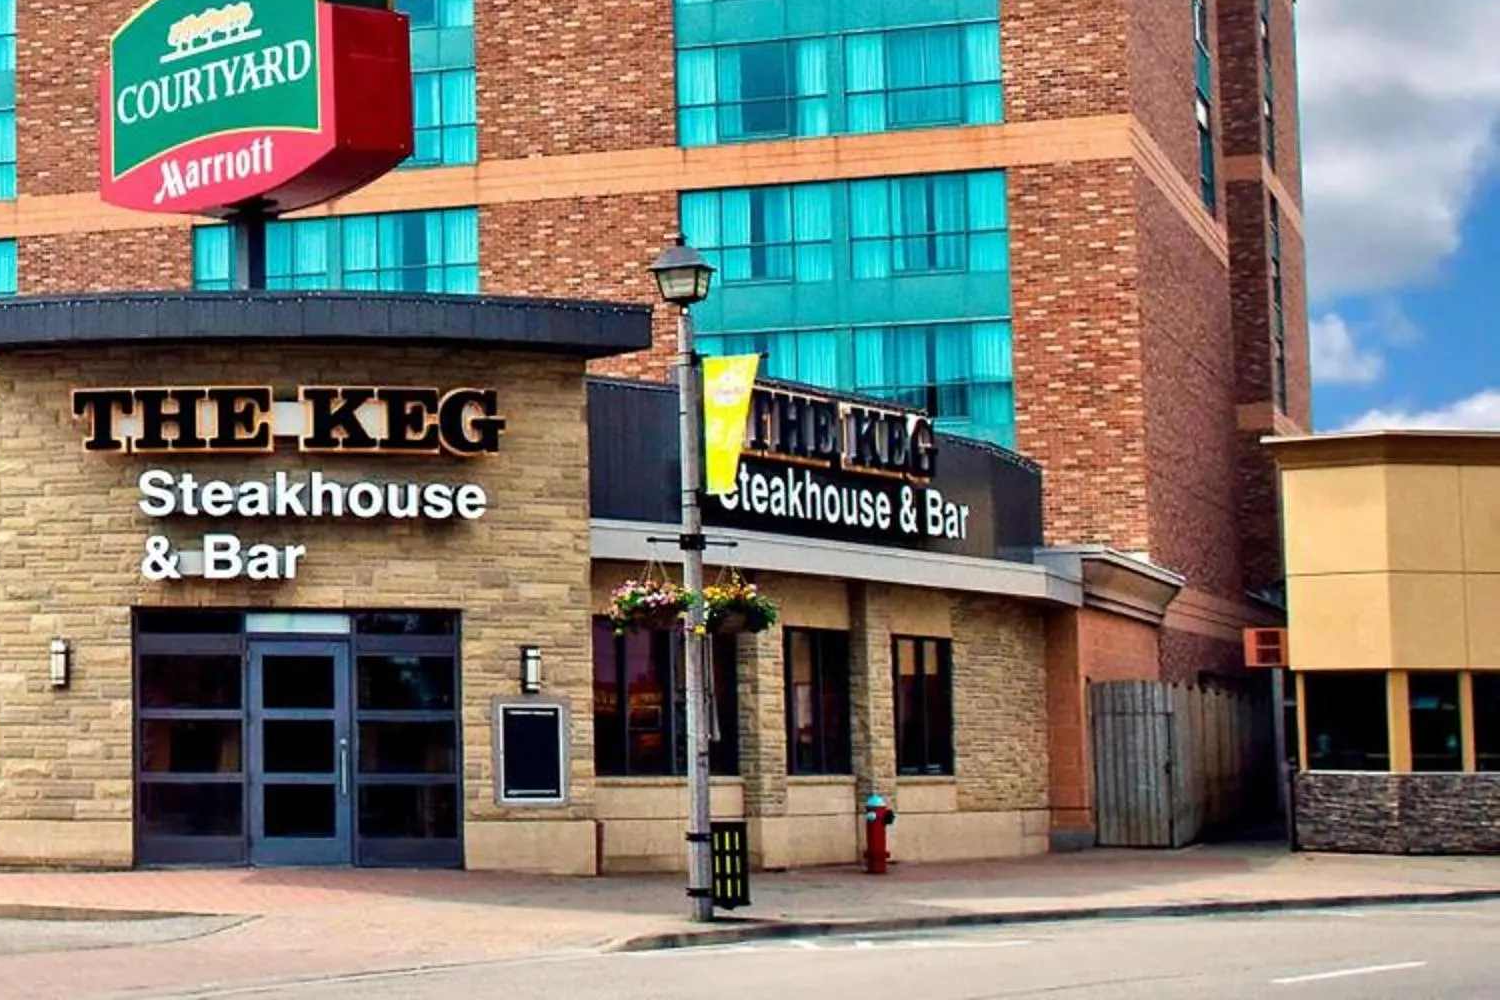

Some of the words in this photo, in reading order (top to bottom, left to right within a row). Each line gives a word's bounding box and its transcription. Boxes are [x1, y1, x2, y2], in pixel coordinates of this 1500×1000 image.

[117, 39, 311, 124] COURTYARD
[153, 136, 274, 204] Marriott
[72, 386, 274, 453] THE
[298, 386, 506, 456] KEG
[838, 400, 938, 484] KEG
[138, 470, 487, 518] Steakhouse
[900, 484, 918, 534] &
[926, 488, 969, 540] Bar
[141, 534, 182, 581] &
[203, 534, 306, 581] Bar
